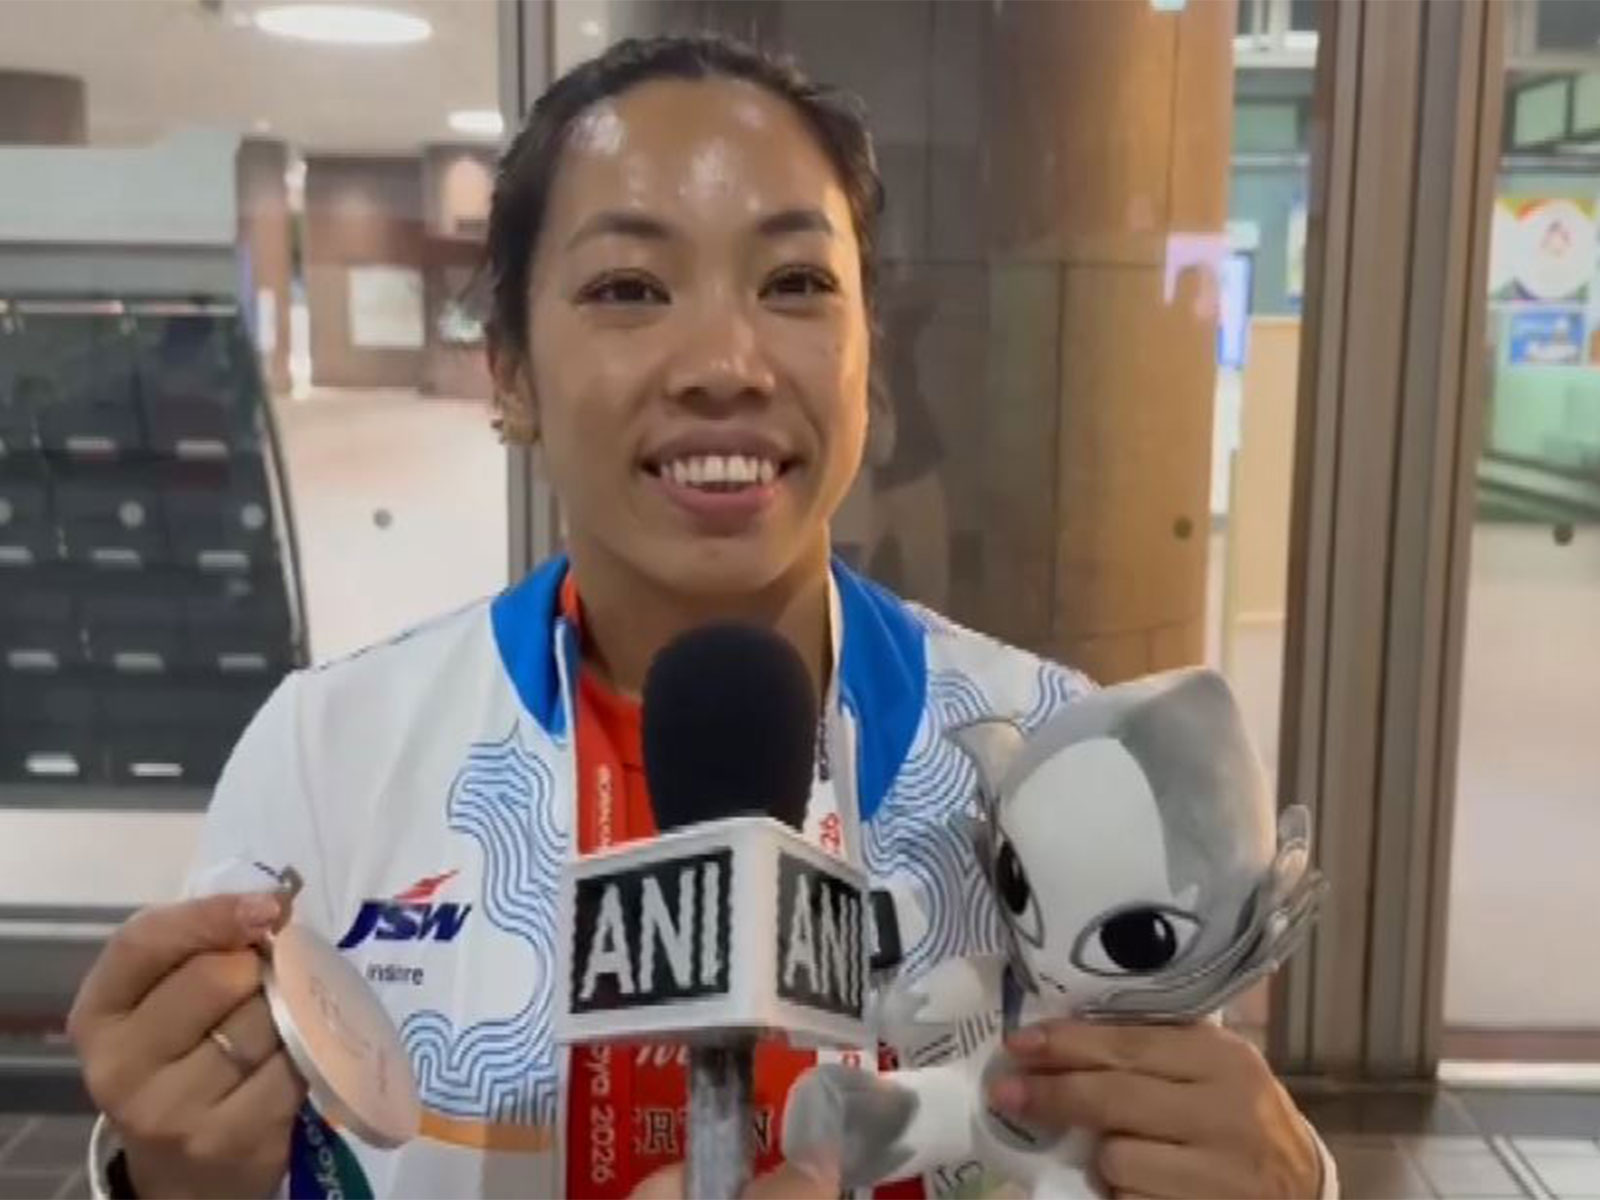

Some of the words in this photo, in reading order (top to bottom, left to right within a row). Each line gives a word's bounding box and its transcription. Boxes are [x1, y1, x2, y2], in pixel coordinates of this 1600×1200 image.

[336, 899, 472, 950] JSW
[578, 860, 723, 1000] ANI
[783, 873, 860, 1008] ANI
[590, 1104, 616, 1187] 2026
